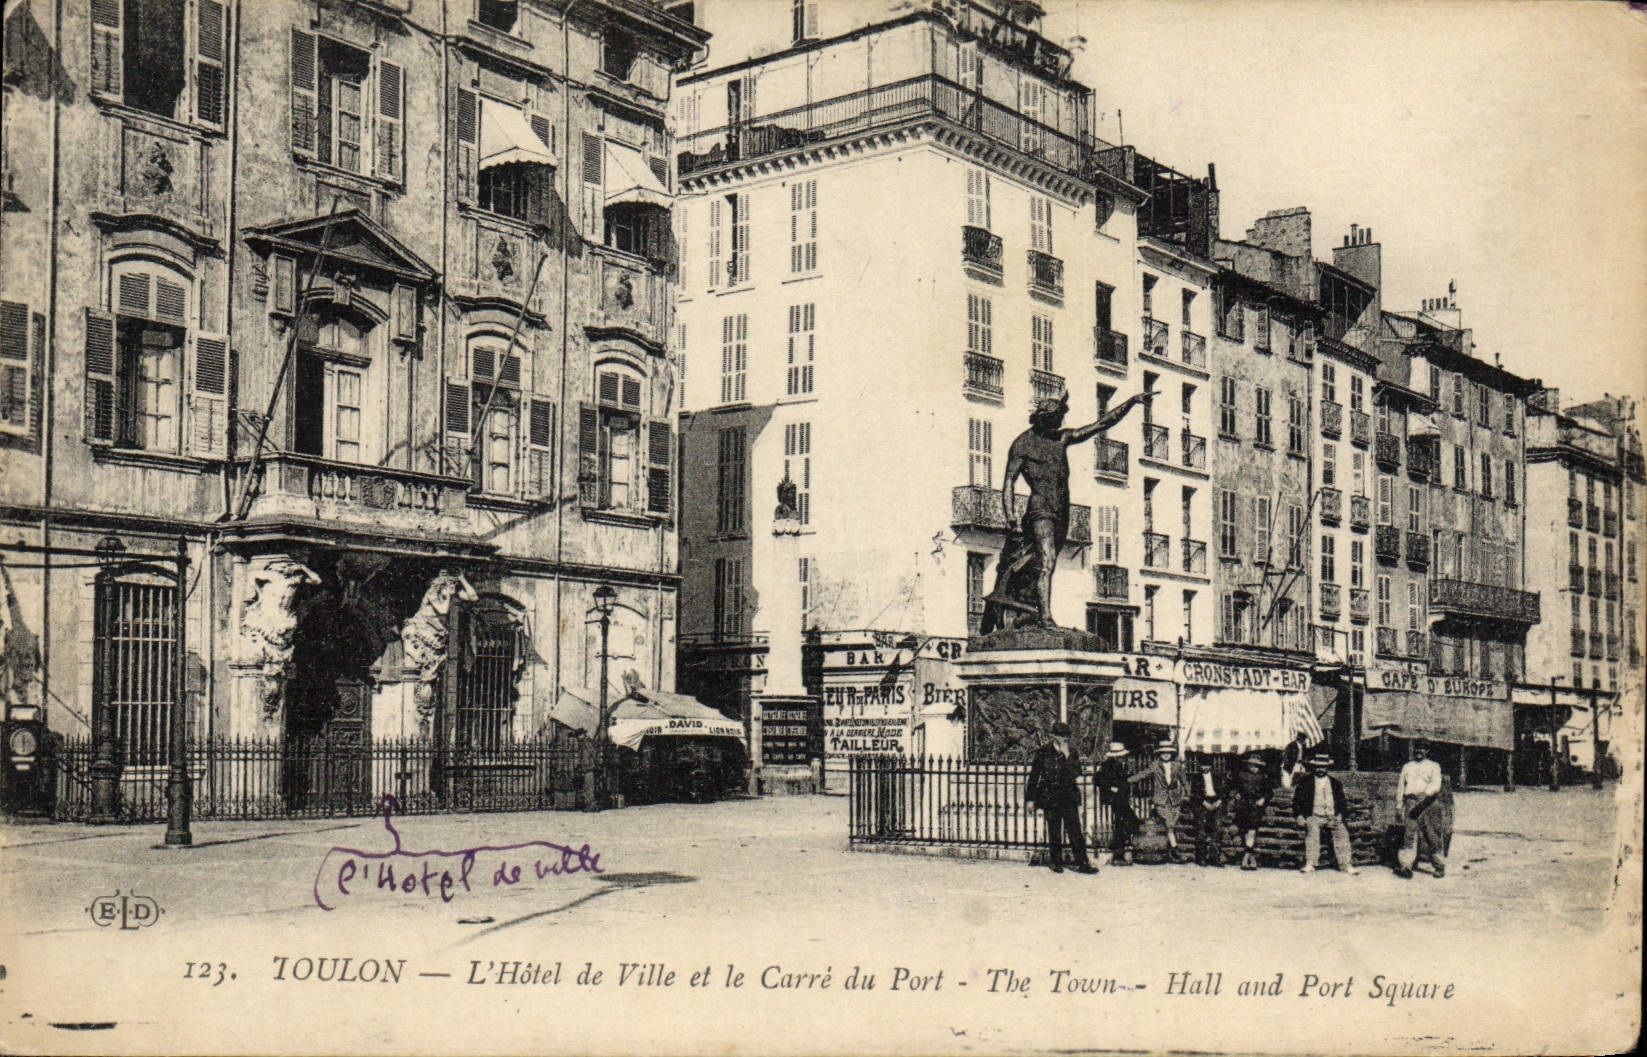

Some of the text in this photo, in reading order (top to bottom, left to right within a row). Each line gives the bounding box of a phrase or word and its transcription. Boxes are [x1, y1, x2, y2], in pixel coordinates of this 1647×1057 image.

[846, 651, 884, 665] BAR
[936, 641, 962, 659] CR
[1182, 662, 1307, 691] CRONSTADT-BAR
[863, 685, 905, 706] PARIS
[1443, 679, 1495, 697] EUROPE
[669, 720, 703, 729] DAVID
[492, 865, 522, 887] de
